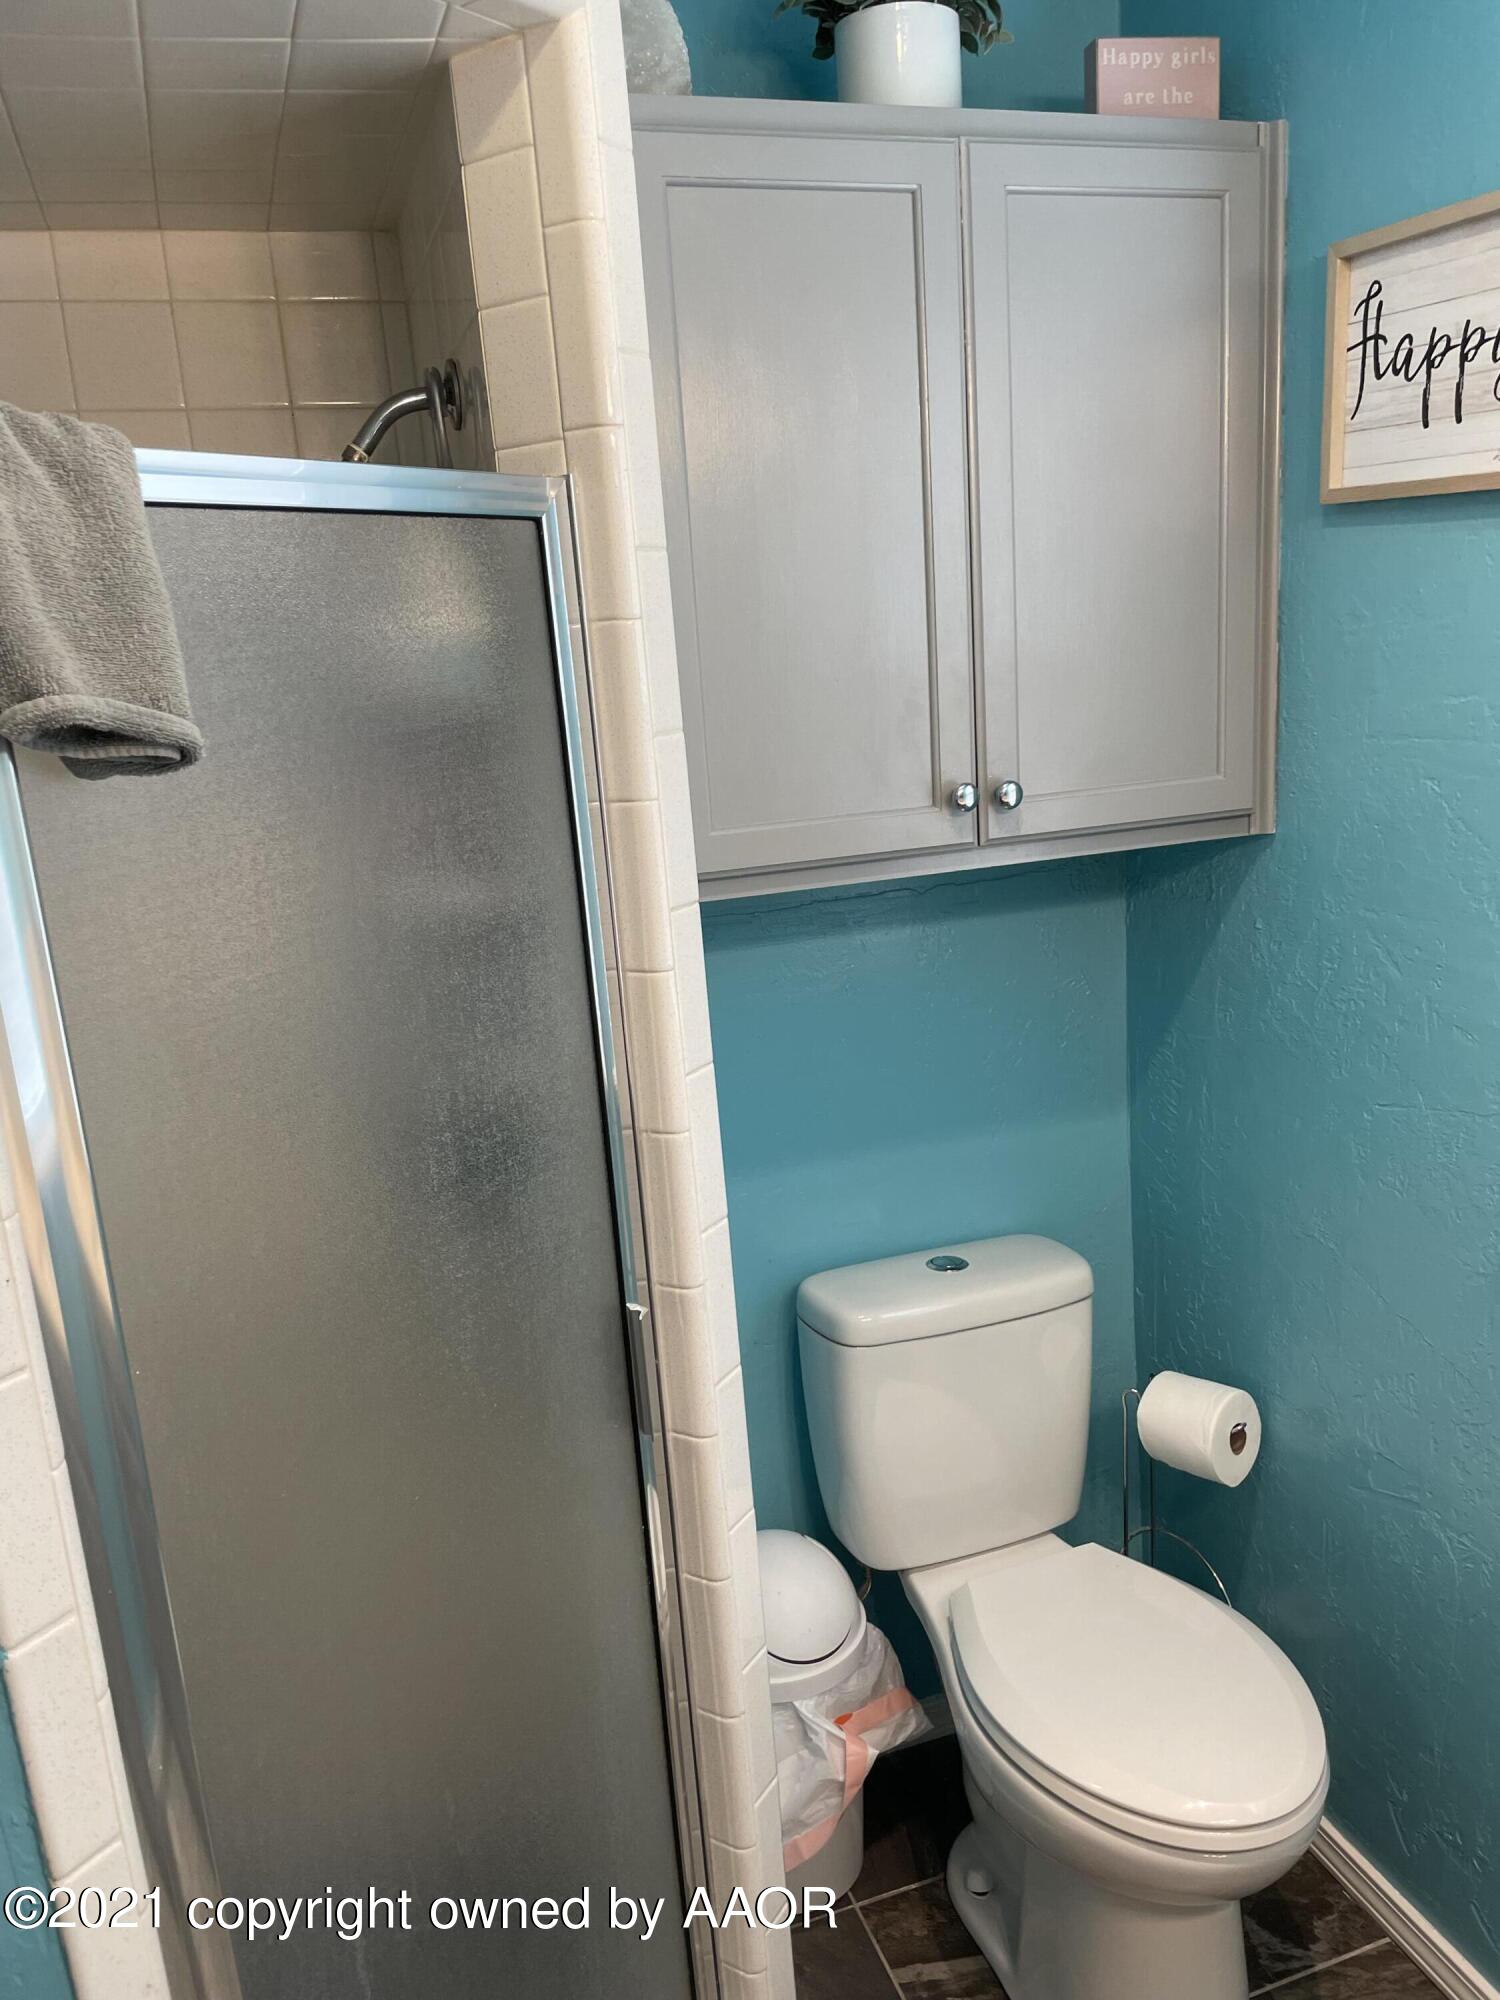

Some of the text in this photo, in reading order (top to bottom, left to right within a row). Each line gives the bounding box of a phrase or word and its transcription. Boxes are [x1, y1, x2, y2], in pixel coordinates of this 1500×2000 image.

[1102, 47, 1216, 69] Happy girls
[1124, 87, 1193, 105] are the
